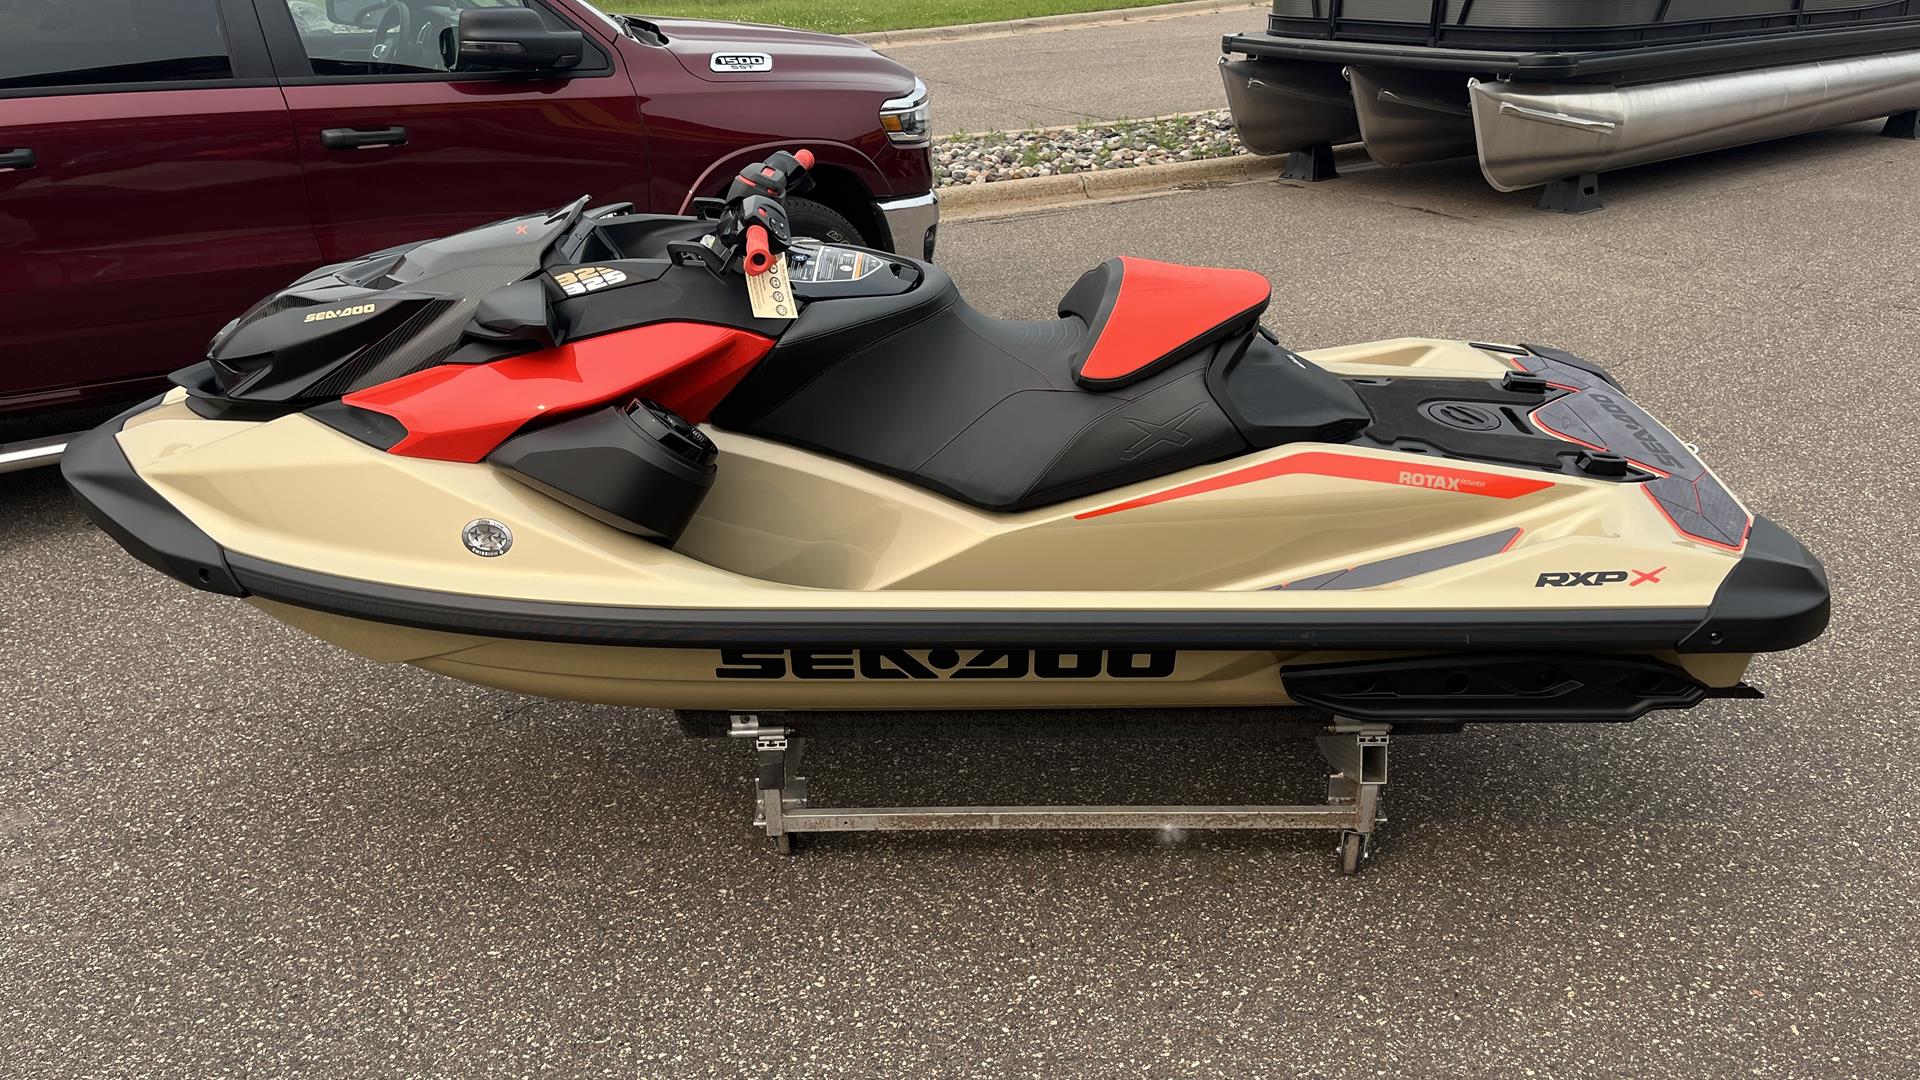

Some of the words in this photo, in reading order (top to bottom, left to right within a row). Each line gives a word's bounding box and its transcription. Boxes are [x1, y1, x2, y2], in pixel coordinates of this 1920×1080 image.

[717, 57, 764, 65] 1500
[562, 270, 628, 295] 325
[1398, 470, 1460, 491] ROTAX
